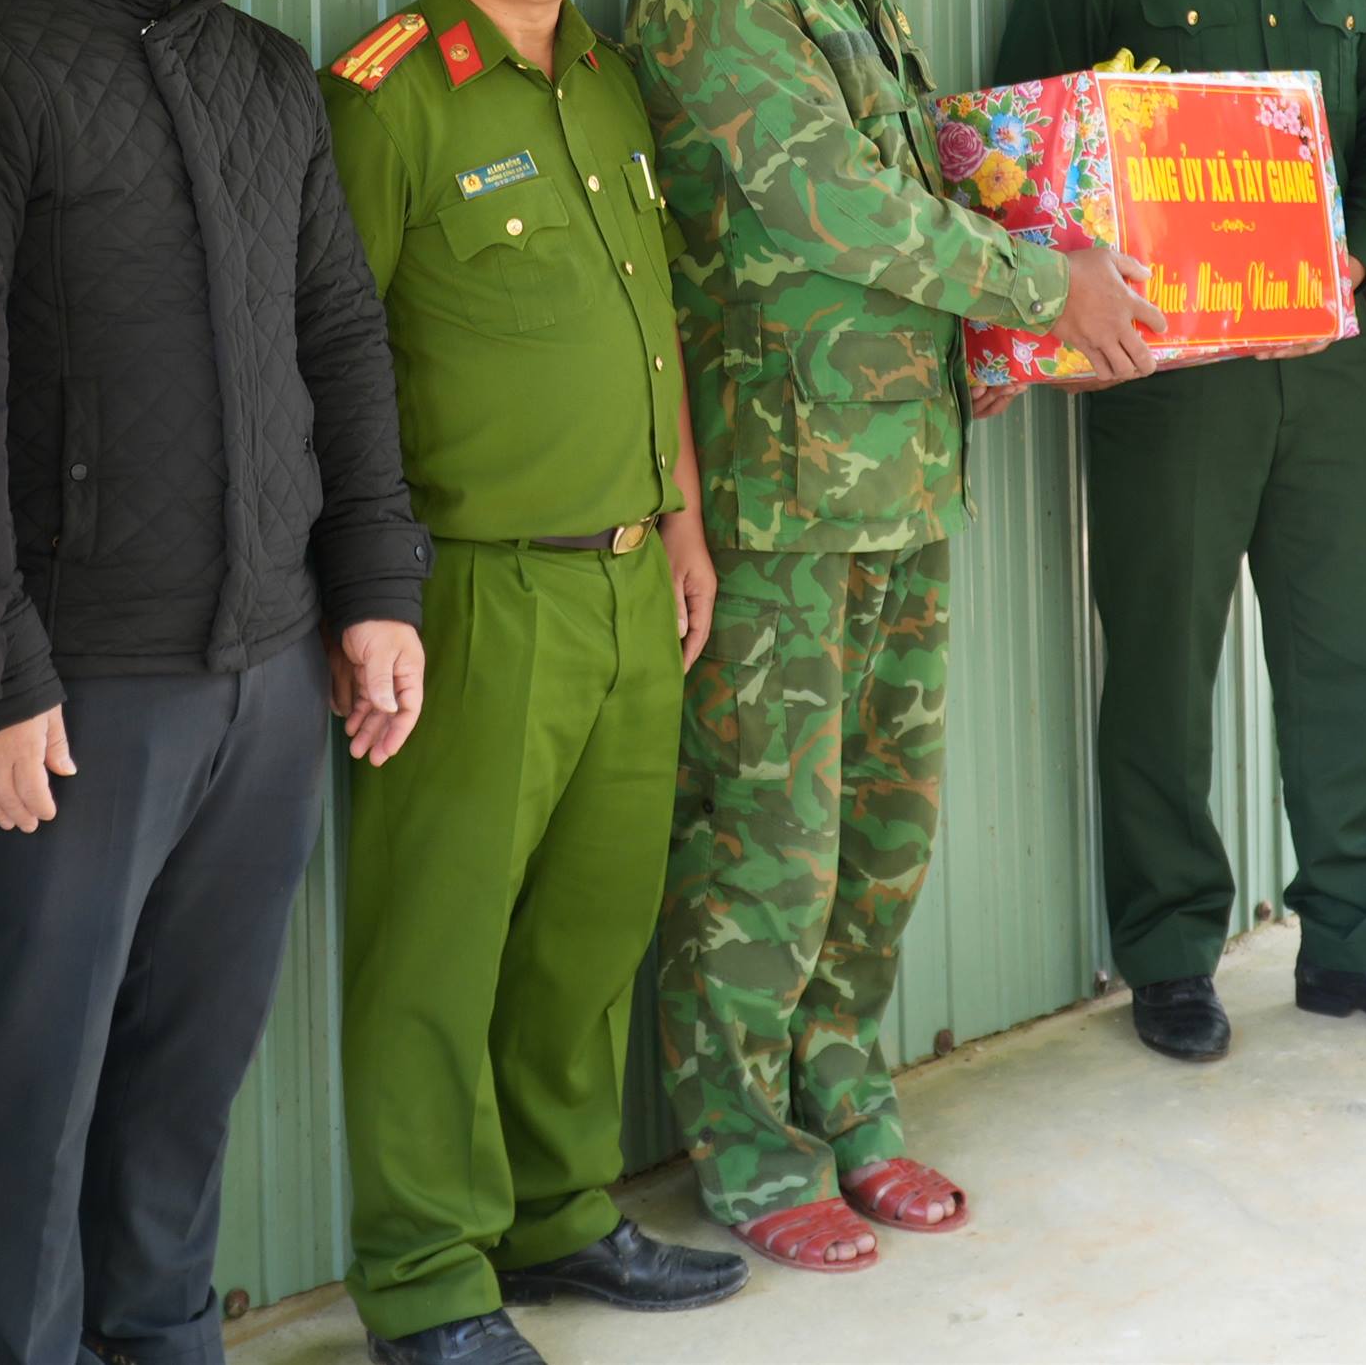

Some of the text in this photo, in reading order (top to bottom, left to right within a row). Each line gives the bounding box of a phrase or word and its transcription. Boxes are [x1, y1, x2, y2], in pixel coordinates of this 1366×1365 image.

[1127, 142, 1318, 204] ĐẢNG ỦY XÃ TÂY GIANG
[1192, 261, 1244, 324] Mừng
[1248, 261, 1289, 312] Năm
